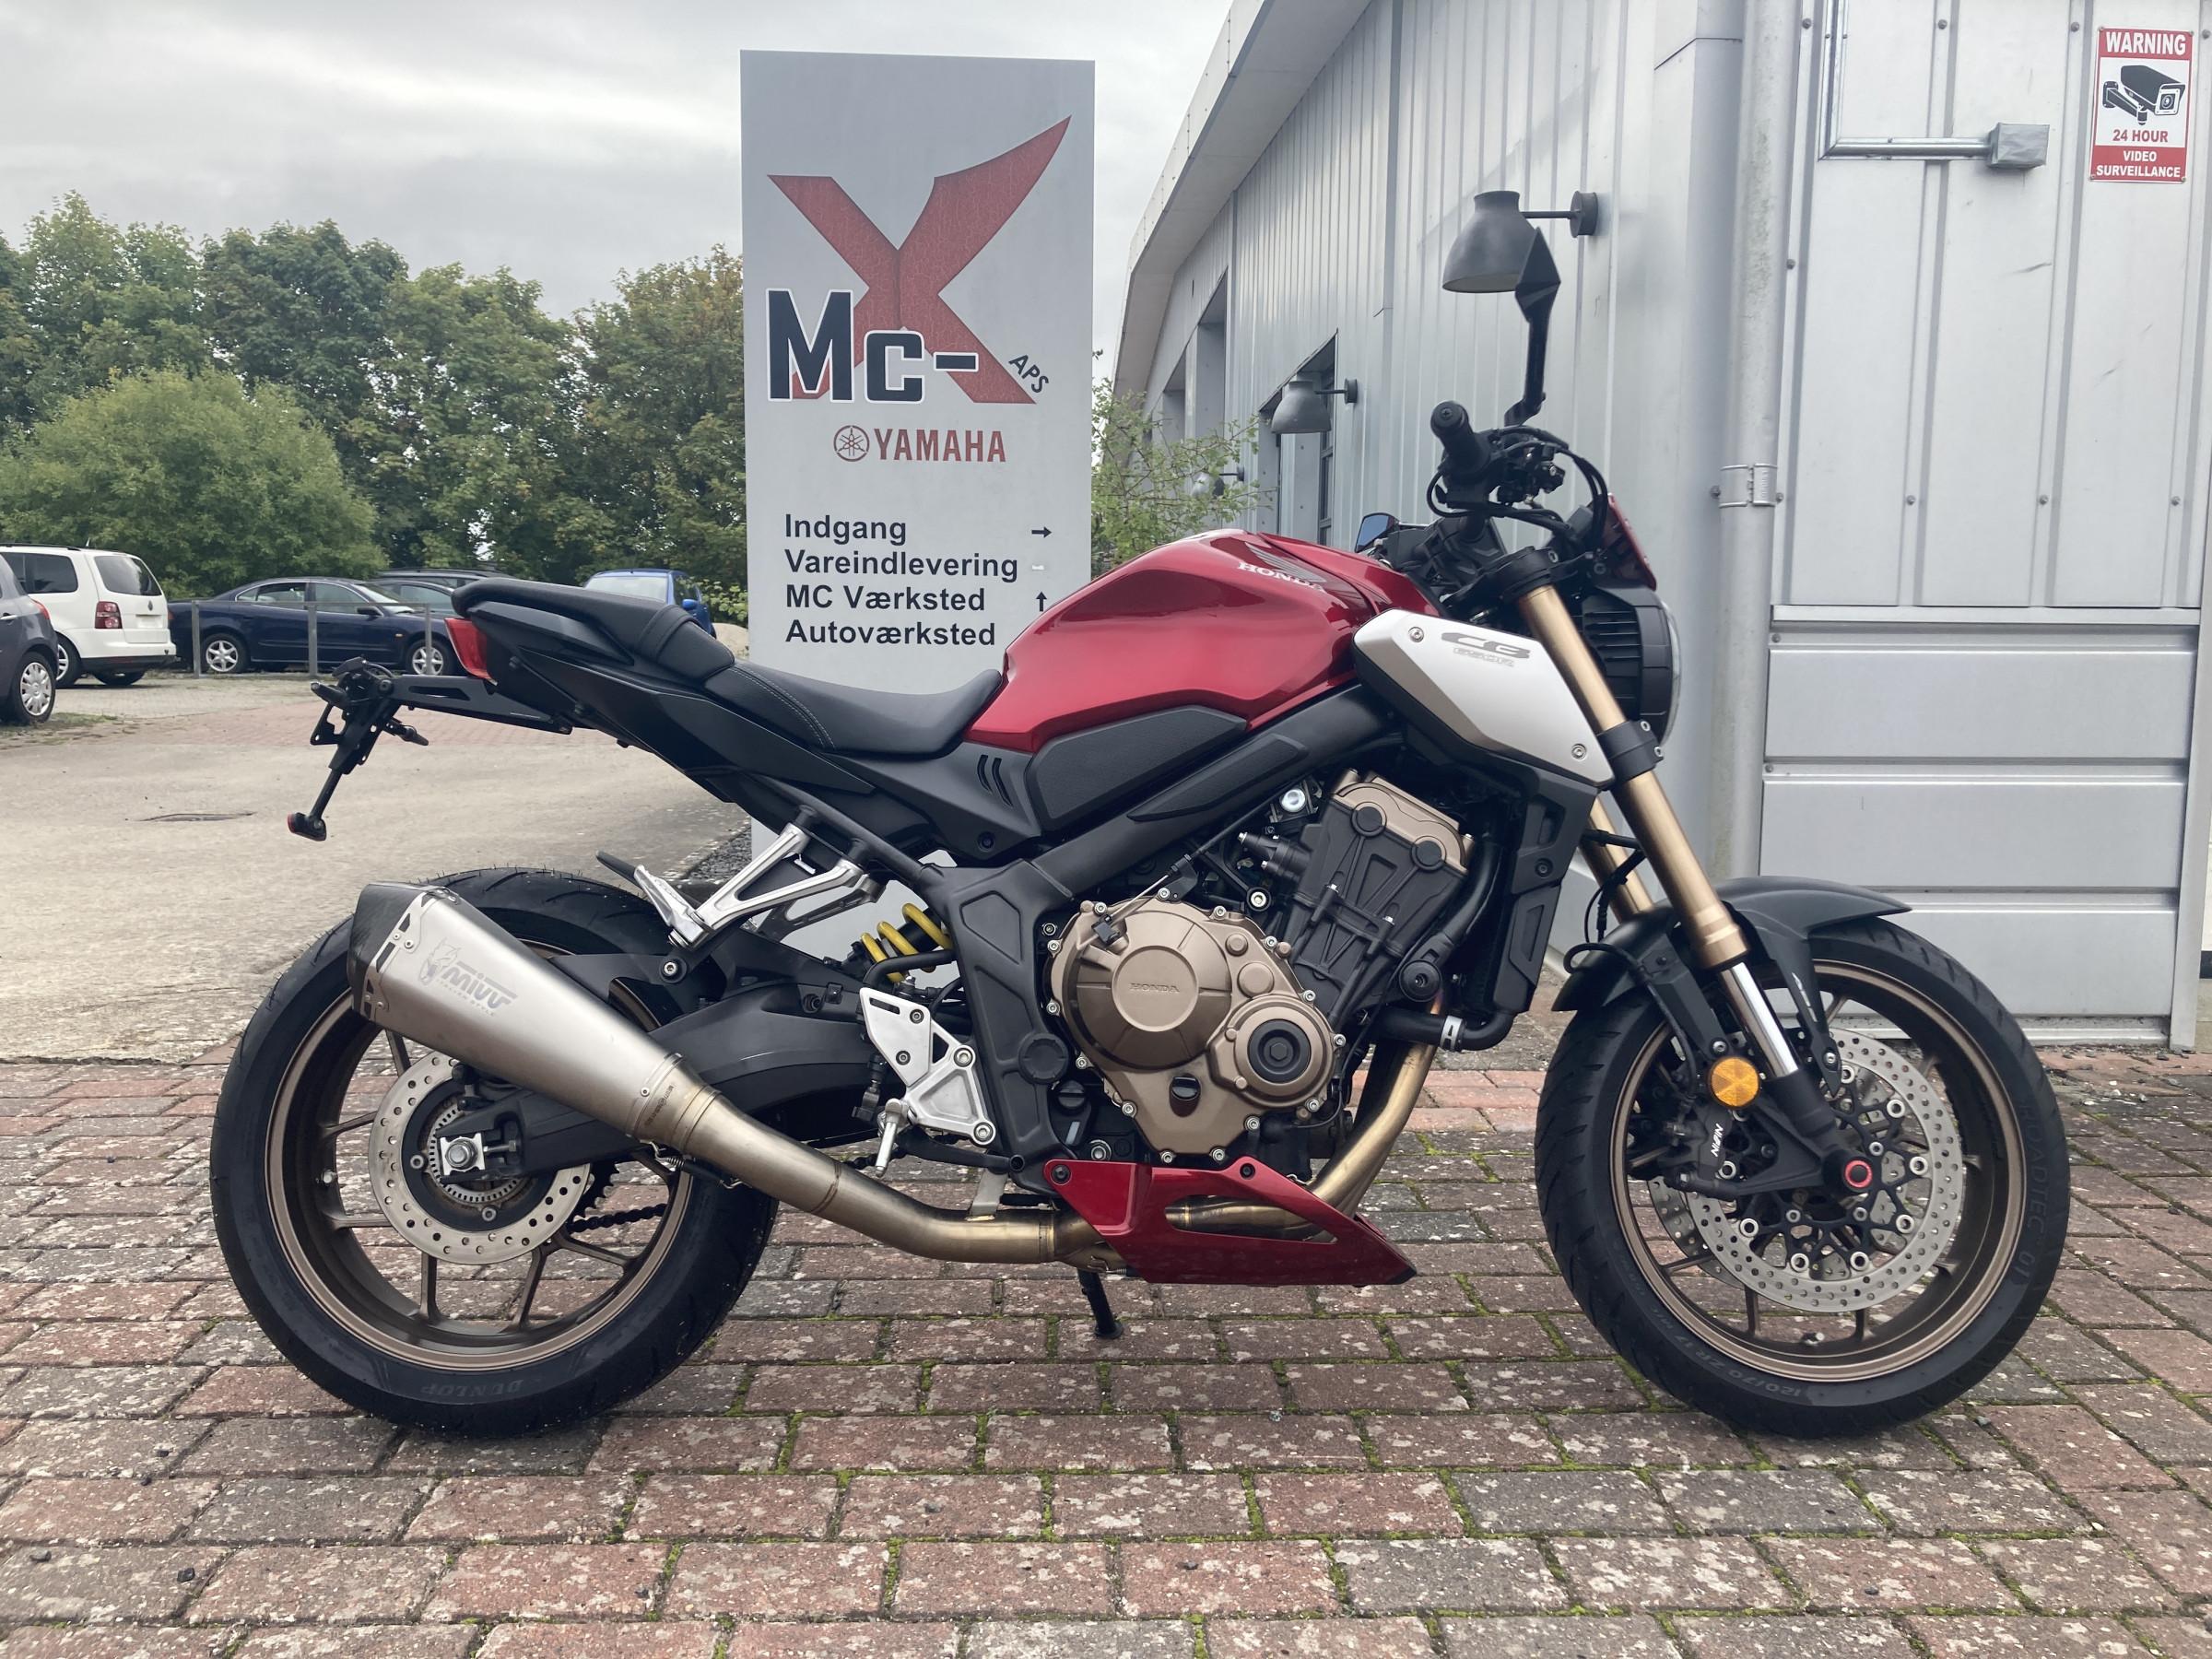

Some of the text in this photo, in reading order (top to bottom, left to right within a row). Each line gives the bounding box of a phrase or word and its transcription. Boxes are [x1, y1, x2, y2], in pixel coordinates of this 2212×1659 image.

[2105, 31, 2187, 55] WARNING
[2112, 129, 2169, 143] 24 HOUR
[2123, 150, 2157, 162] VIDEO
[2096, 165, 2181, 178] SURVEILLANCE
[1007, 353, 1050, 394] APS
[873, 428, 1006, 463] YAMAHA
[784, 513, 907, 547] Indgang
[784, 549, 1018, 583] Vareindlevering
[1238, 561, 1327, 594] HONDA
[785, 584, 985, 611] MC Værksted
[785, 619, 995, 646] Autoværksted
[1130, 982, 1181, 994] HONDA
